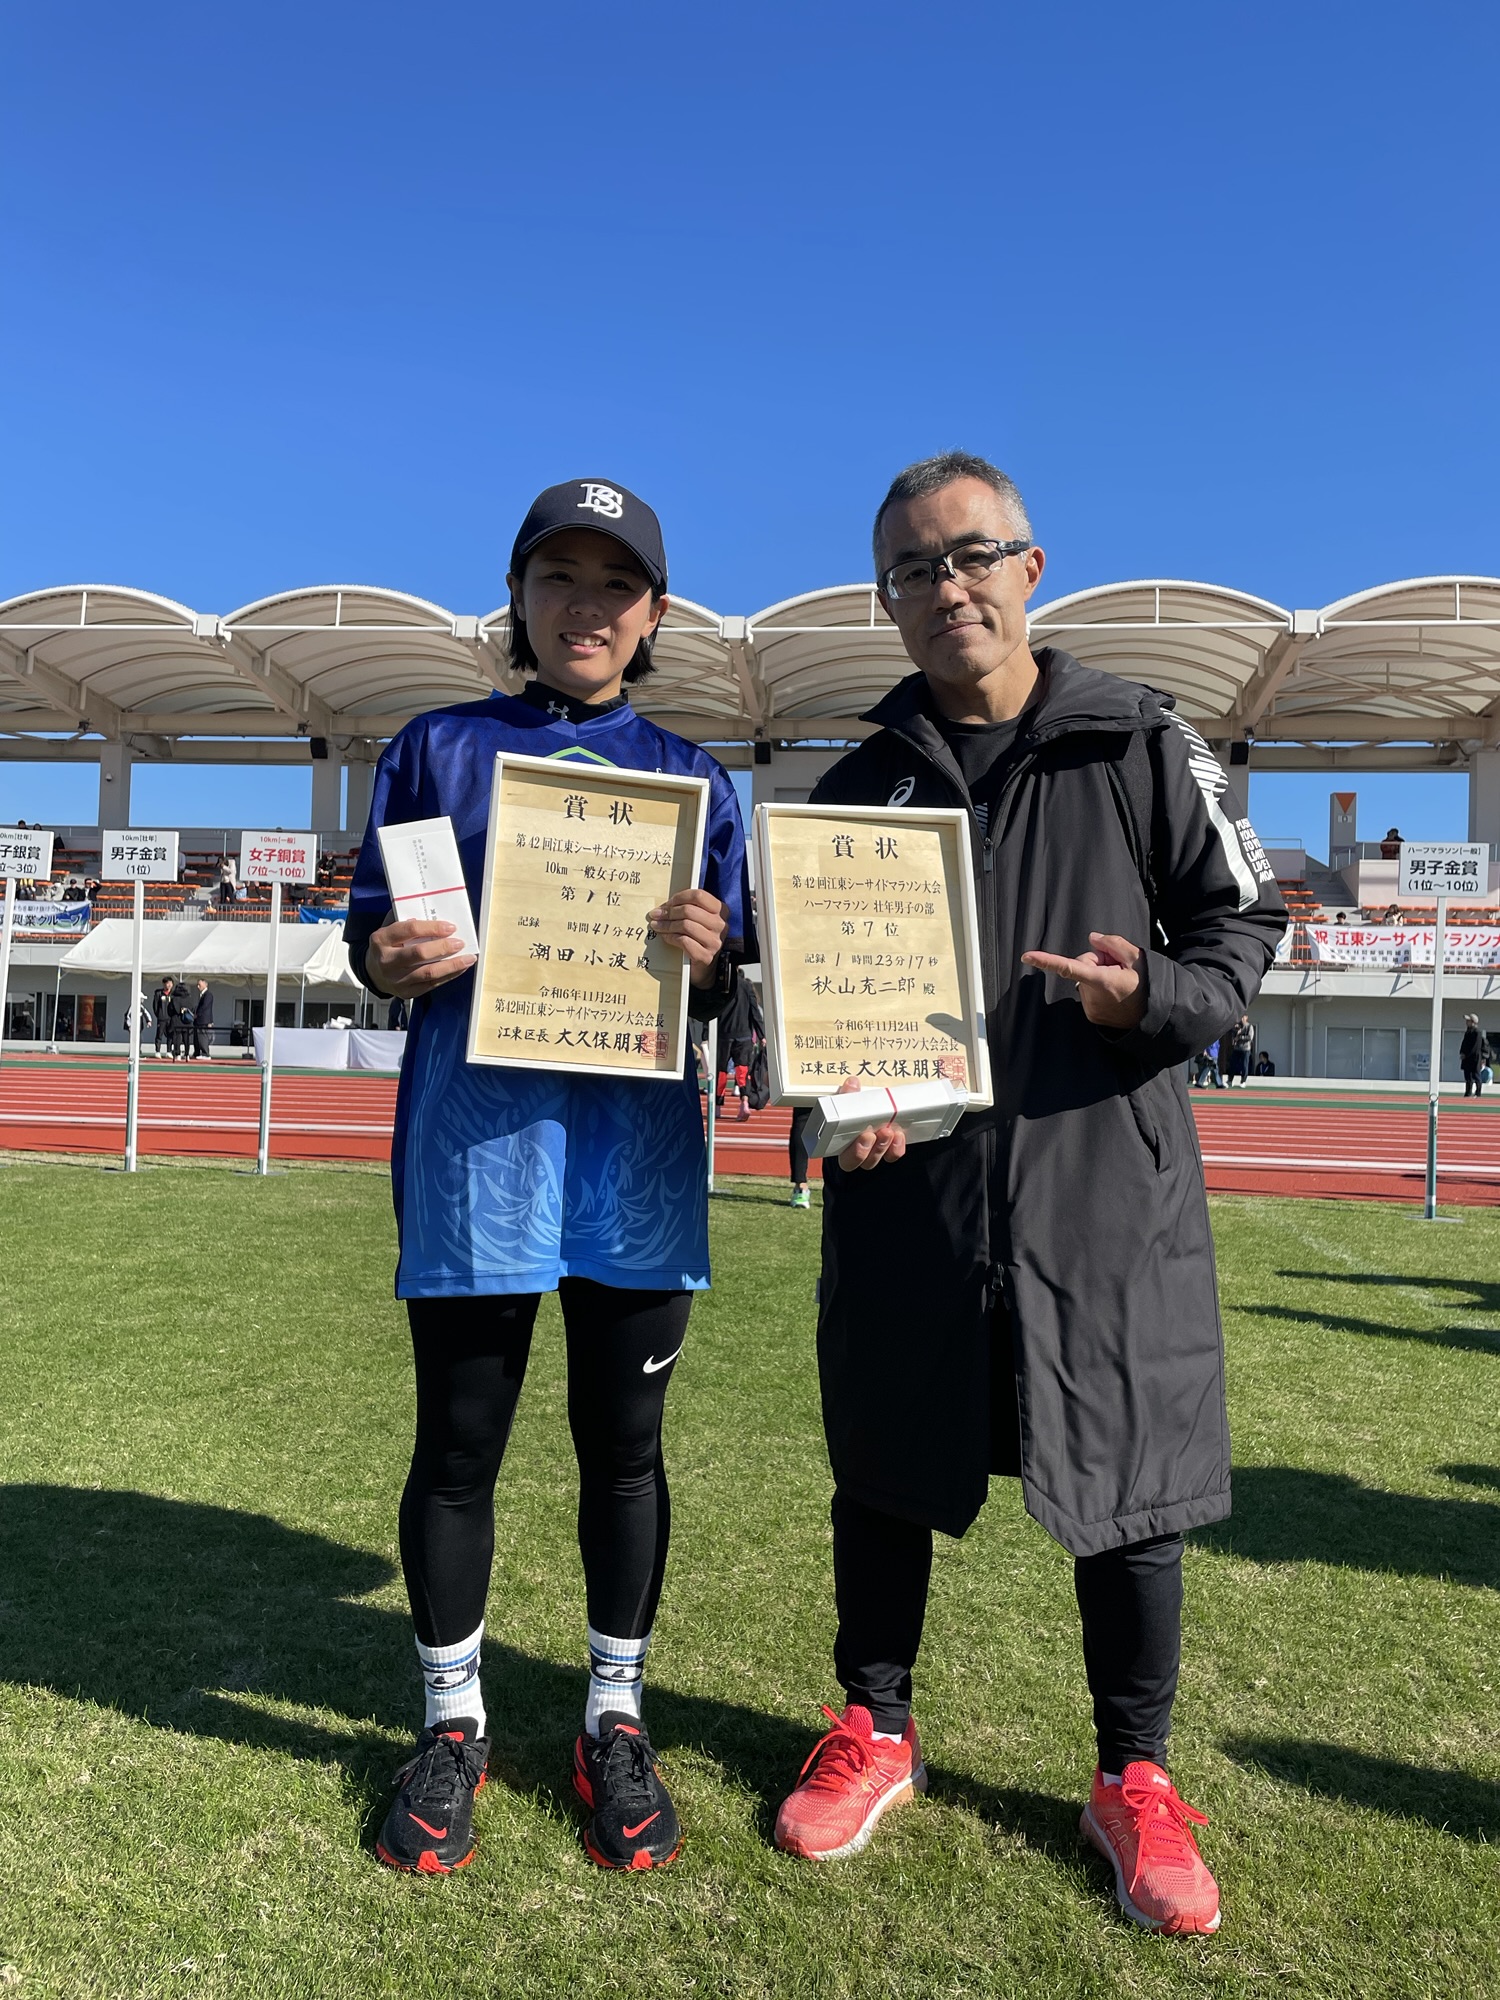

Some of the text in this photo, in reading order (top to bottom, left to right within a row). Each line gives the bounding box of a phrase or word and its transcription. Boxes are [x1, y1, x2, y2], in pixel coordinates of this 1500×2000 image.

[564, 794, 633, 826] 賞状
[110, 846, 167, 861] 男子金賞
[832, 834, 899, 860] 賞状
[249, 847, 306, 864] 女子銅賞
[545, 861, 641, 885] 10km 一般女子の部
[1409, 860, 1478, 876] 男子金賞
[804, 899, 935, 915] ハーフマラソン 壮年男子の部
[517, 916, 540, 928] 記録
[636, 956, 649, 970] 殿
[804, 953, 826, 964] 記録
[538, 985, 627, 1006] 令和6年11月24日
[923, 983, 935, 995] 殿
[833, 1018, 919, 1032] 令和6年11月24日
[497, 1026, 550, 1043] 江東区長
[554, 1028, 650, 1054] 大久保朋果
[800, 1061, 851, 1076] 江東区長
[856, 1058, 950, 1080] 大久保朋果
